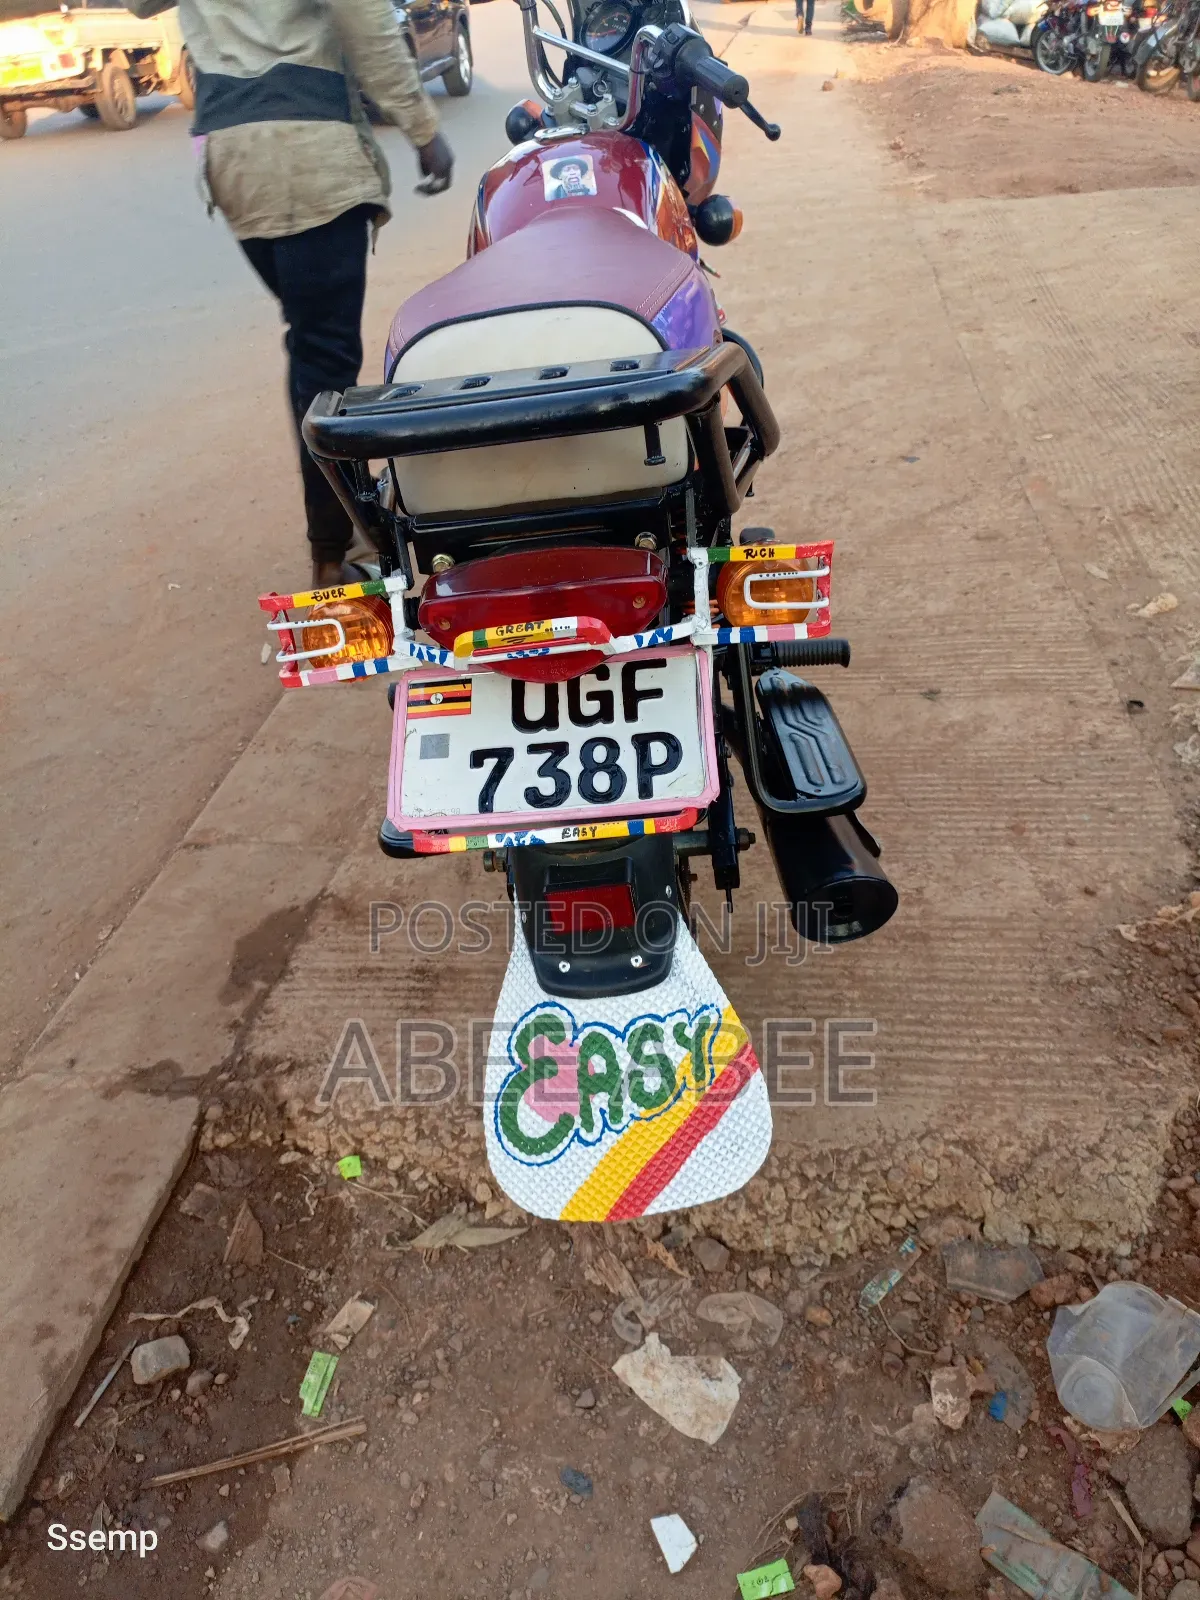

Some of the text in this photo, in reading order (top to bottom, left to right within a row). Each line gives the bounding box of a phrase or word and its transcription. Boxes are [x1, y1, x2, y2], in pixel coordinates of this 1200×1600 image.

[743, 548, 775, 559] RICH
[511, 657, 667, 733] UGF
[469, 731, 683, 814] 738P
[561, 825, 598, 840] EASY
[499, 1013, 712, 1156] EASY
